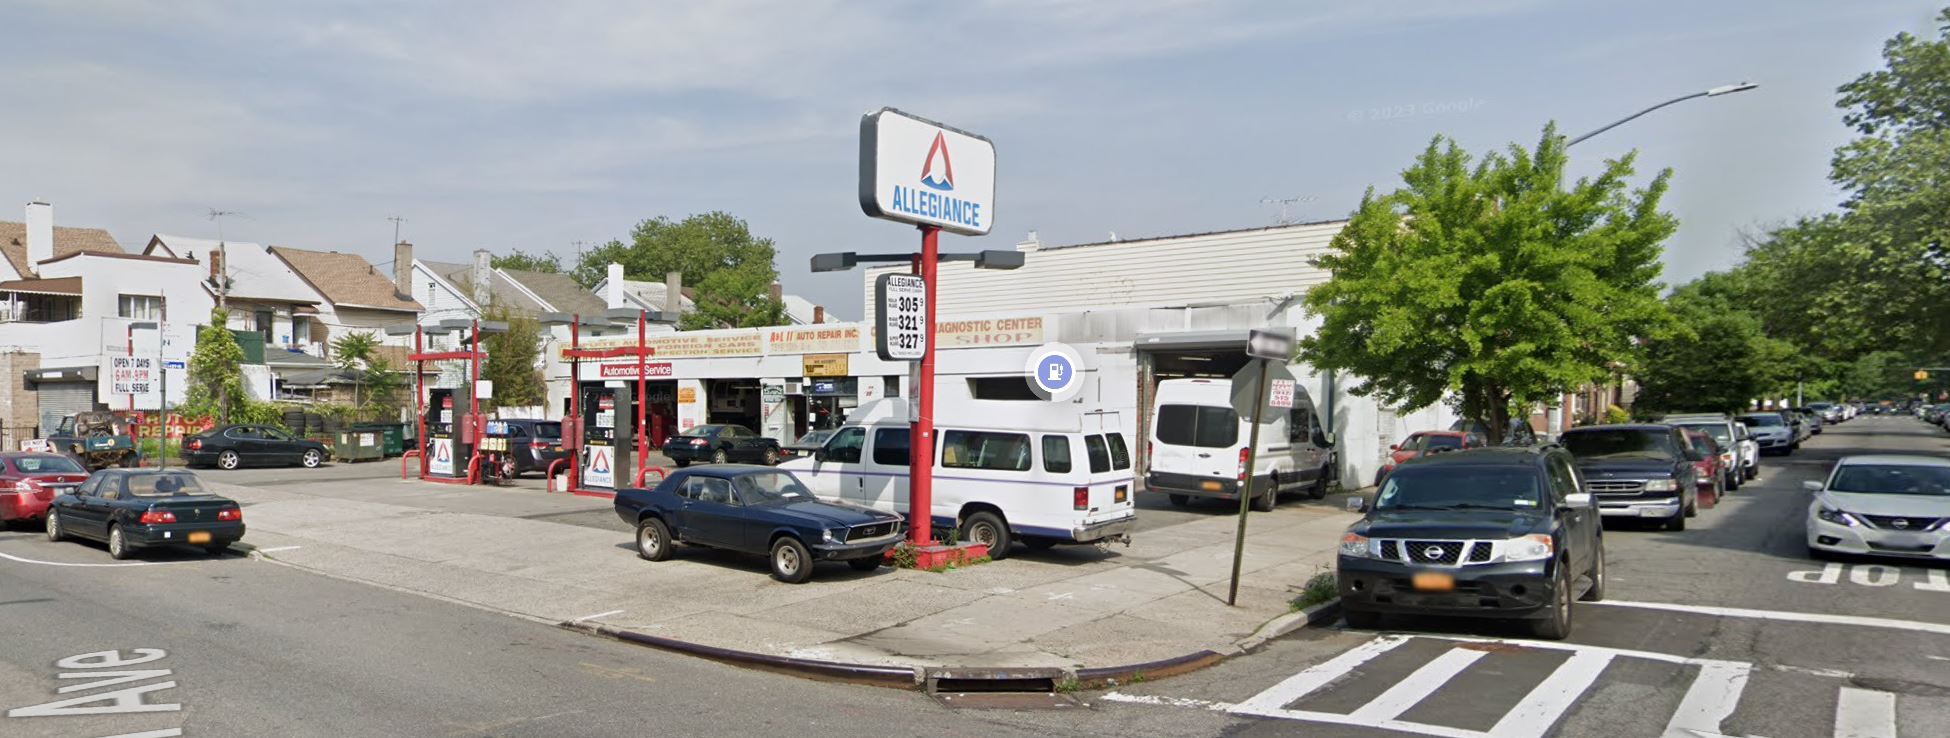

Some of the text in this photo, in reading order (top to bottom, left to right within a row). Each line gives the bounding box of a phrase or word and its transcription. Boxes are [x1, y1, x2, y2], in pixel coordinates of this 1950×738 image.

[892, 184, 980, 227] ALLEGIANCE
[887, 276, 923, 288] ALLEGIANCE
[898, 297, 918, 312] 305
[898, 315, 918, 331] 321
[935, 316, 1042, 334] IAGNOSTIC CENTER
[706, 334, 762, 343] SERVICE
[796, 330, 815, 341] AUTO
[816, 329, 842, 340] REPAIR
[899, 333, 918, 349] 327
[955, 332, 1033, 345] SHOP
[655, 347, 761, 357] SPECTION SERVICE
[656, 342, 713, 350] FOREIGN
[114, 357, 130, 368] OPEN
[136, 357, 150, 368] DAYS
[603, 364, 672, 376] Automotive Service
[115, 383, 129, 393] FULL
[144, 413, 199, 424] AUTO
[138, 425, 204, 437] REPAIR
